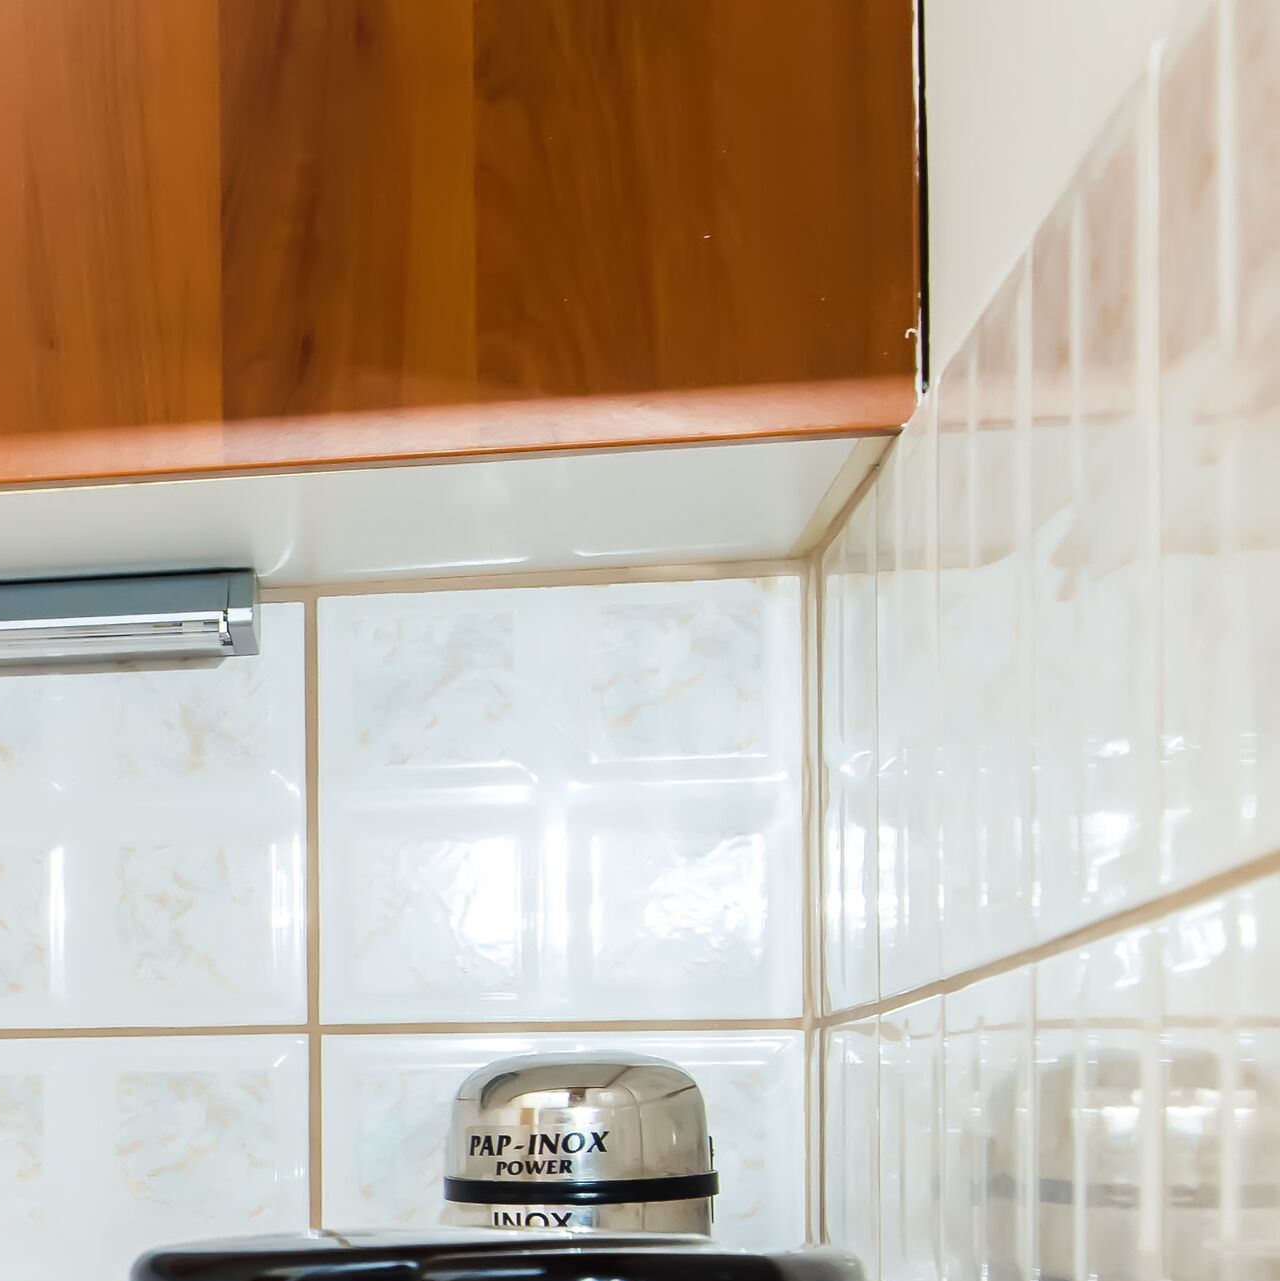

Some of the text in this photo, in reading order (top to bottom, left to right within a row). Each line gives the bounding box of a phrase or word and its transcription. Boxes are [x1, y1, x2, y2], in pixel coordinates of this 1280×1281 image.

[469, 1131, 610, 1157] PAP-INOX
[495, 1159, 573, 1176] POWER
[493, 1211, 573, 1227] INOX
